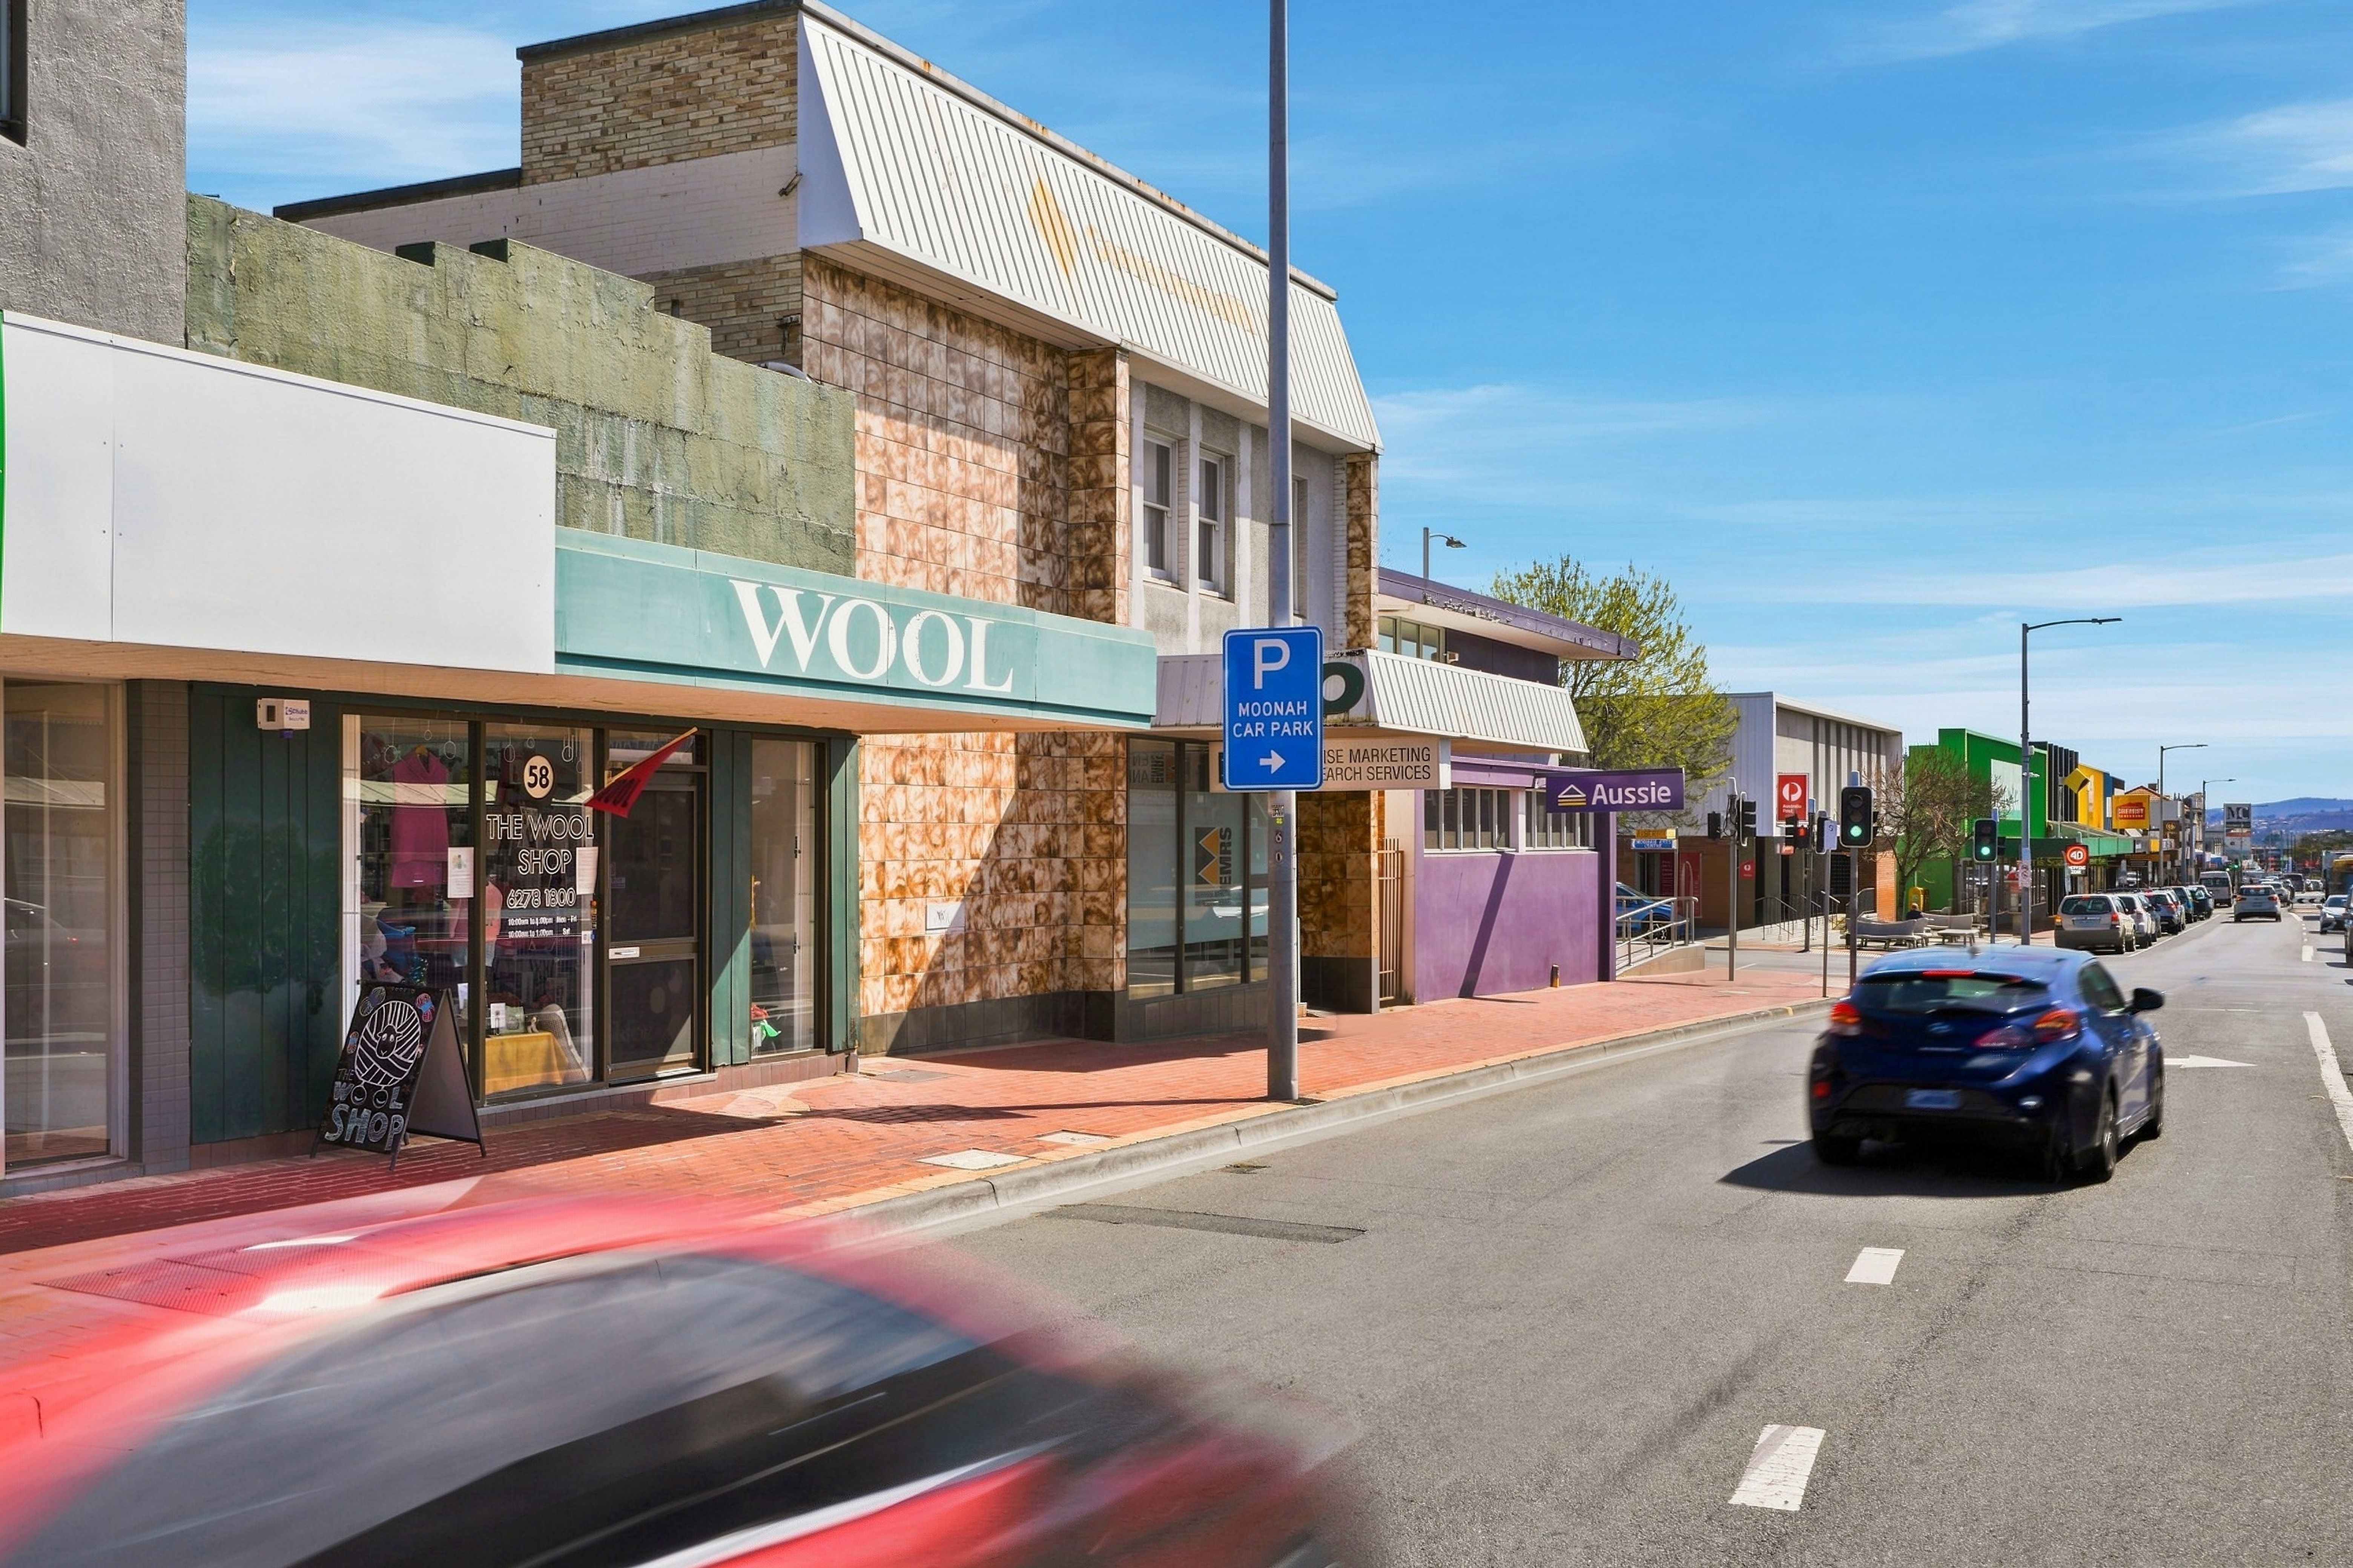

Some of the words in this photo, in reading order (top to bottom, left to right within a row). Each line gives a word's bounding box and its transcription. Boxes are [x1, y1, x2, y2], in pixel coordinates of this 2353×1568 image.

[729, 579, 1013, 693] WOOL
[1254, 639, 1290, 689] P
[1239, 701, 1306, 717] MOONAH
[1233, 722, 1265, 738] CAR
[1271, 721, 1313, 736] PARK
[1349, 747, 1431, 763] MARKETING
[528, 765, 549, 788] 58
[1367, 765, 1431, 780] SERVICES
[1592, 781, 1671, 805] Aussie
[487, 815, 523, 839] THE
[528, 814, 594, 841] WOOL
[518, 849, 572, 875] SHOP
[1219, 827, 1232, 885] EMRS
[2070, 850, 2084, 860] 40
[507, 888, 541, 909] 6278
[544, 887, 576, 907] 1800
[338, 1068, 355, 1080] THE
[333, 1081, 404, 1109] WOOL
[324, 1103, 404, 1151] SHOP
